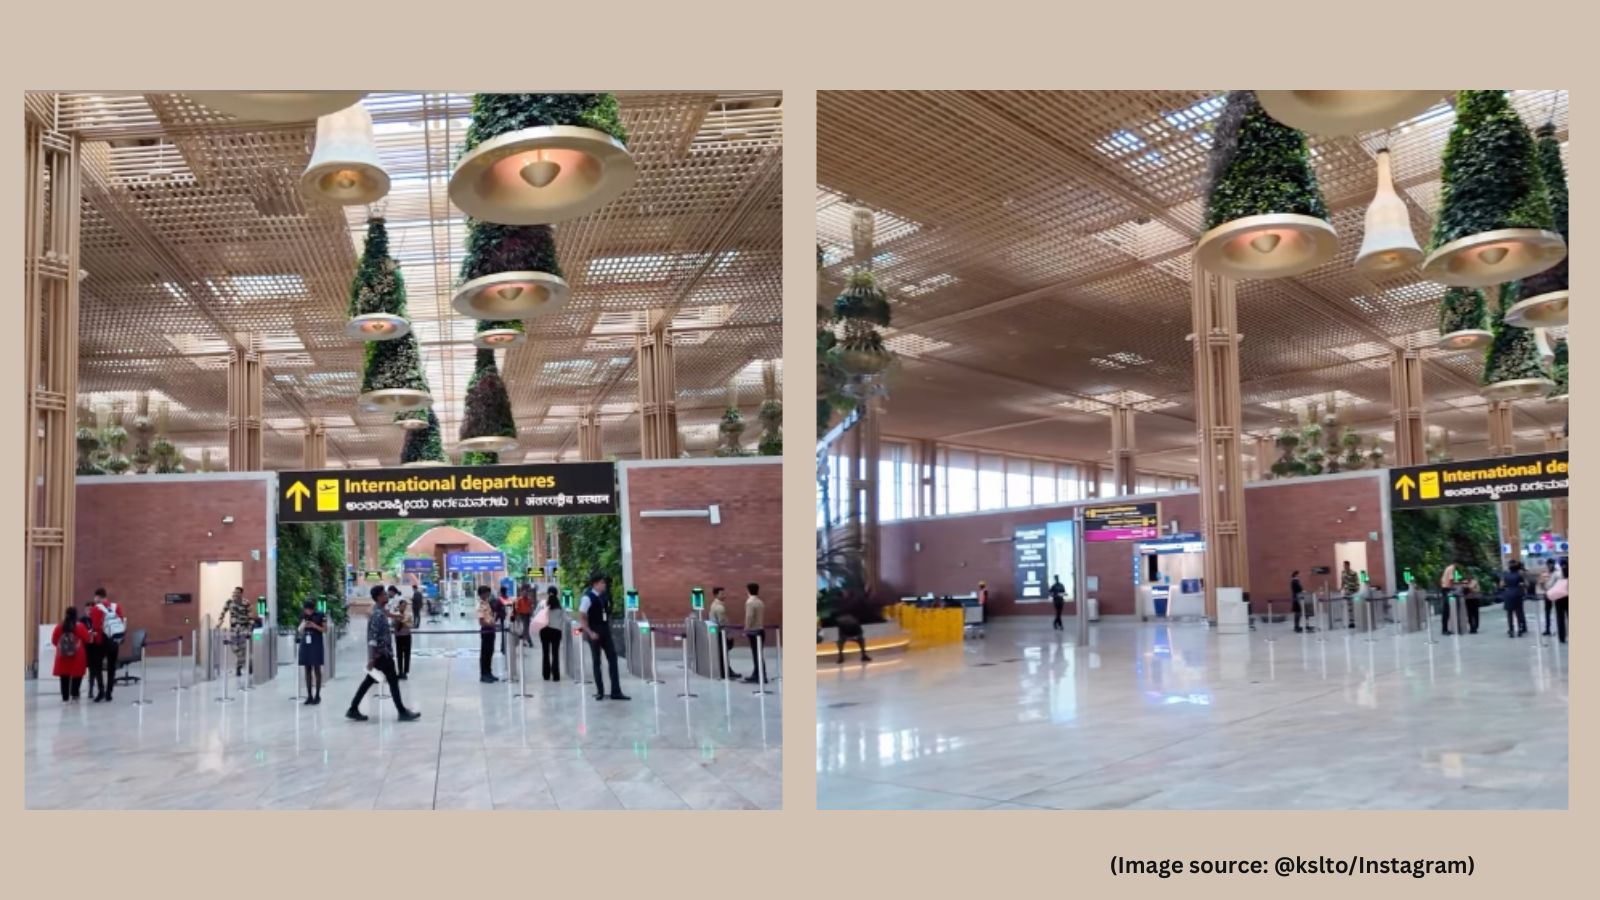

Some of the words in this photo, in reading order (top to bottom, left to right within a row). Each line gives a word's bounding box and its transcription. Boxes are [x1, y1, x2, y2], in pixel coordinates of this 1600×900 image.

[1443, 461, 1542, 482] International
[1546, 459, 1568, 474] de
[345, 475, 456, 494] International
[460, 474, 556, 493] departures
